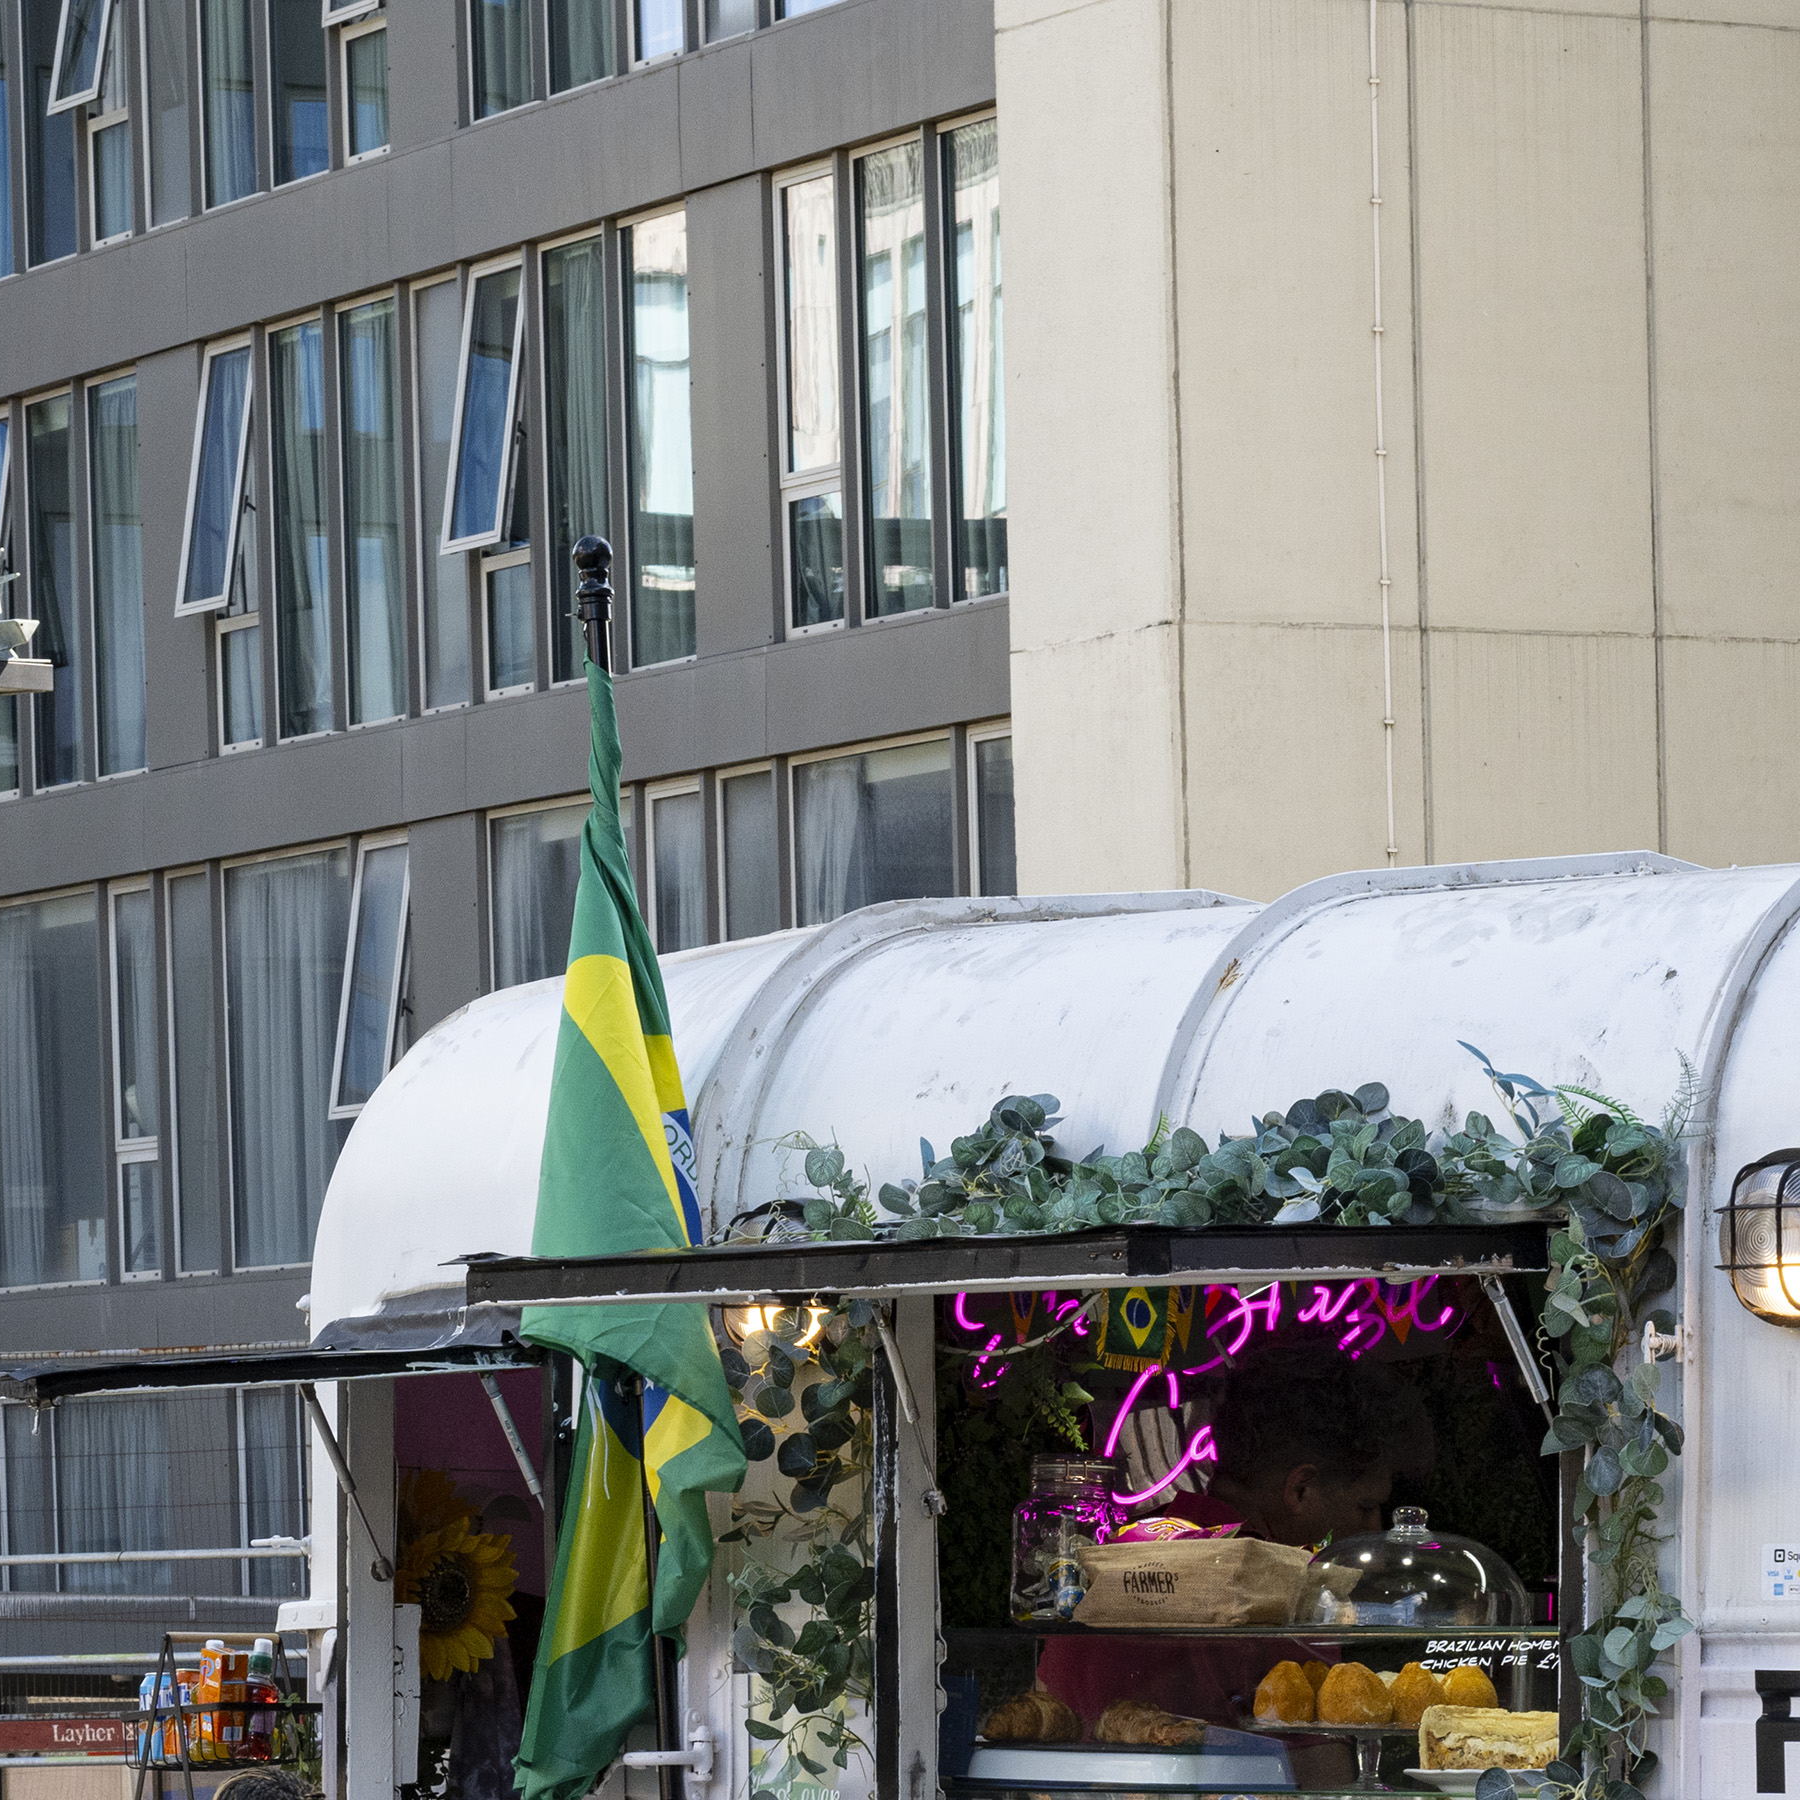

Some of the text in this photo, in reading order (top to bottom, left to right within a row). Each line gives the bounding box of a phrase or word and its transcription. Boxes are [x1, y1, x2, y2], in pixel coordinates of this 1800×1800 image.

[1425, 1639, 1506, 1654] BRAZILIAN
[1419, 1656, 1492, 1670] CHICKEN
[1501, 1655, 1528, 1666] PIE
[52, 1723, 115, 1746] Layher
